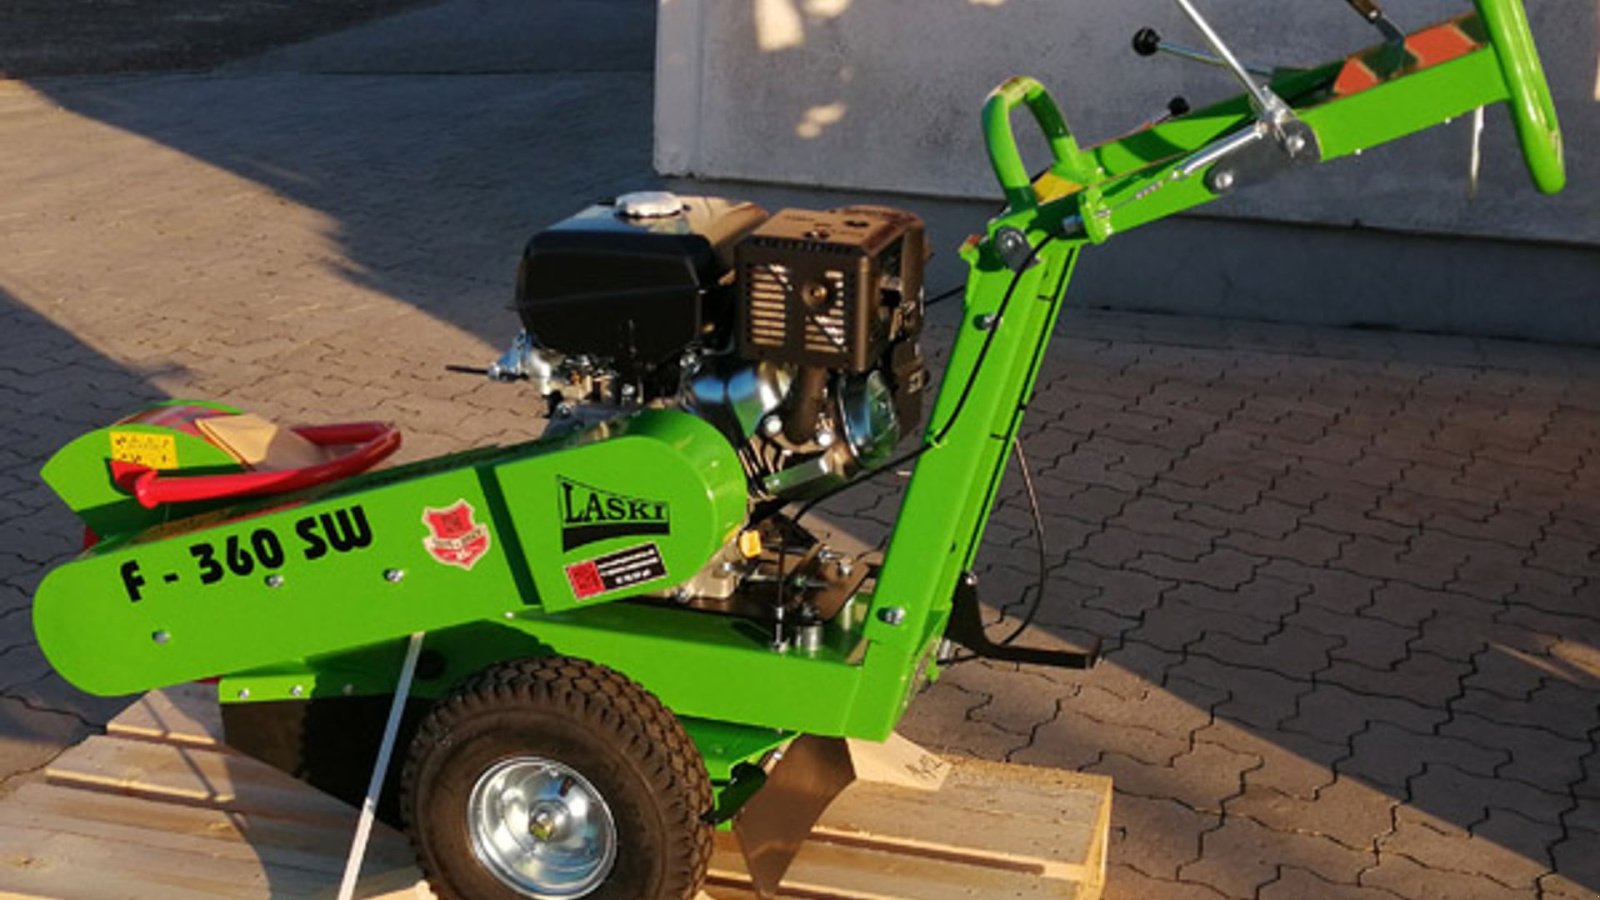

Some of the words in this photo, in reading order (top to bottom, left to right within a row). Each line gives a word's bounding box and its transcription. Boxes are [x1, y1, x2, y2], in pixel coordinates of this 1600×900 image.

[562, 482, 664, 522] LASKI
[120, 560, 145, 602] F
[189, 528, 284, 584] 360
[295, 504, 373, 560] SW
